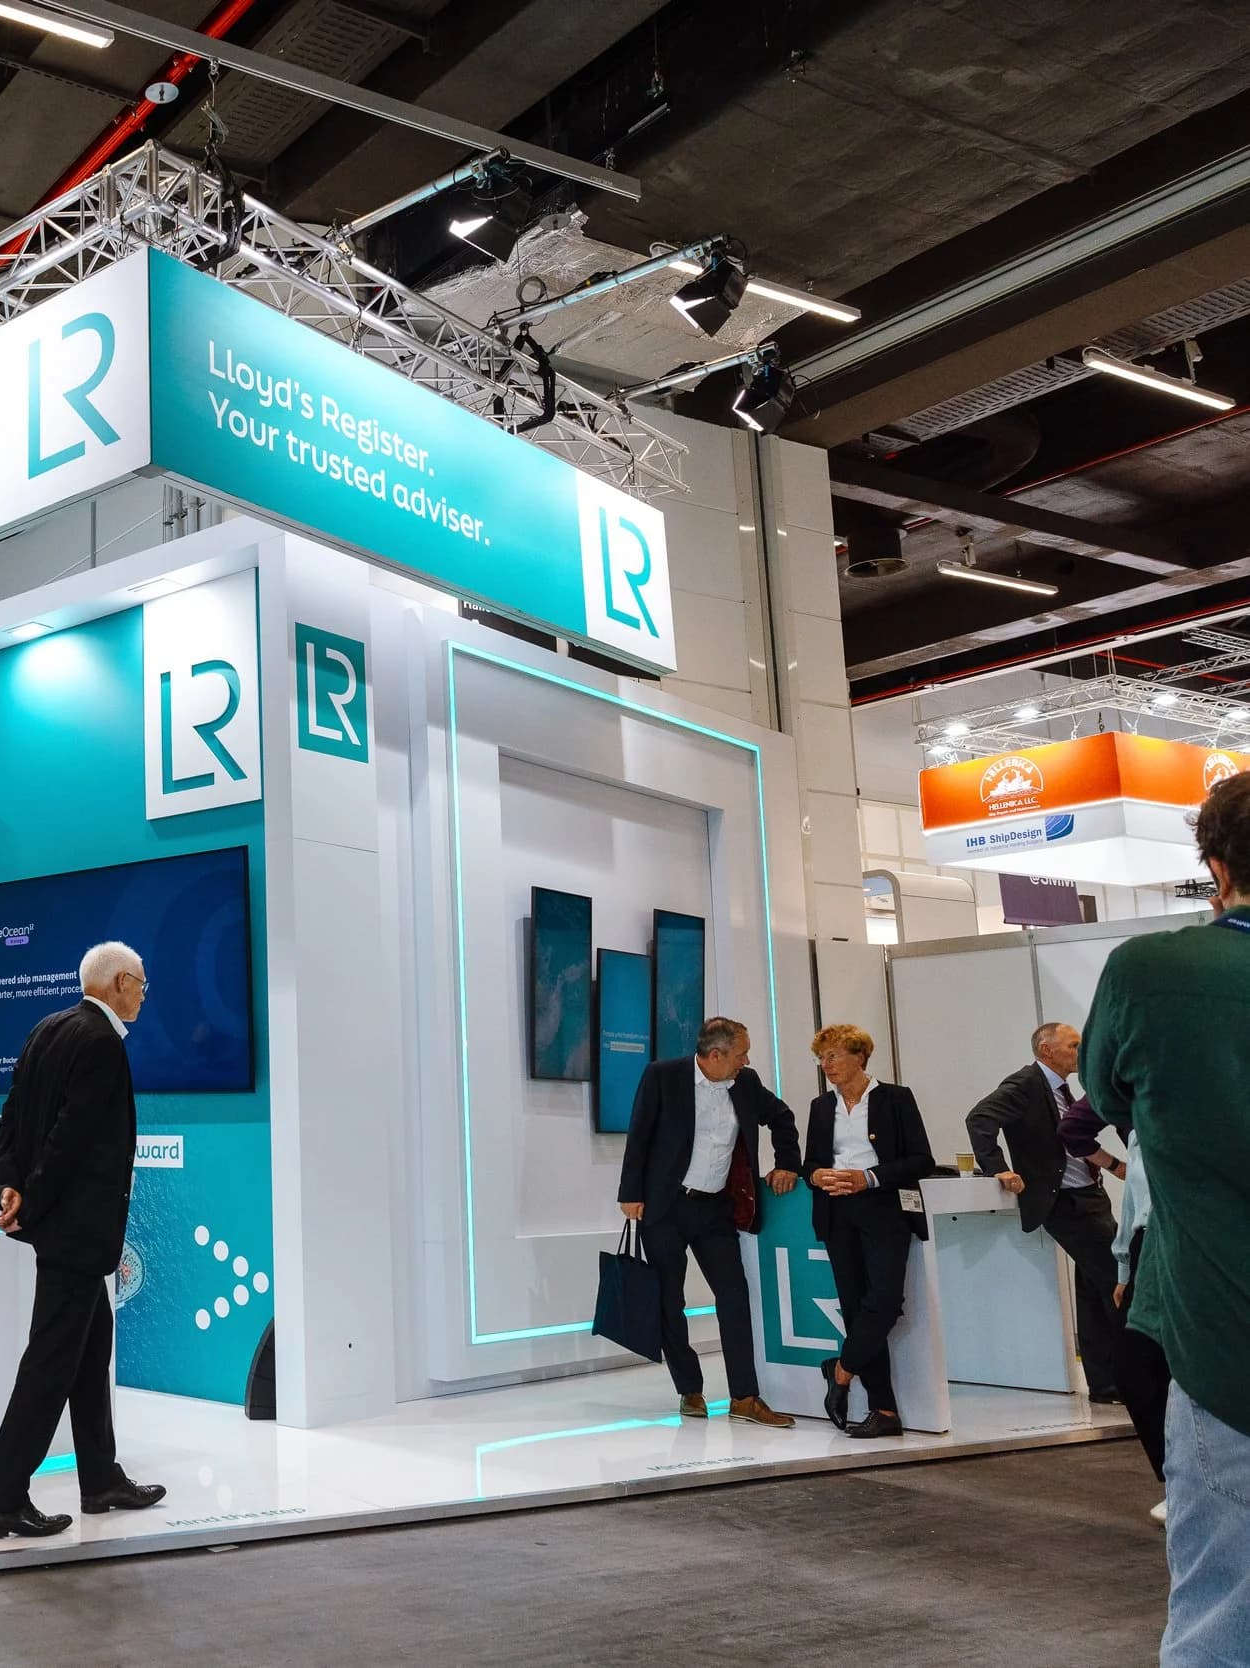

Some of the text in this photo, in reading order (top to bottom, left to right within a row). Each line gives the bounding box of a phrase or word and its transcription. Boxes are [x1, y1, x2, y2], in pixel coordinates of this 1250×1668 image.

[28, 312, 121, 480] LR
[209, 340, 435, 477] Lloyd's Register.
[208, 391, 490, 546] Your trusted adviser.
[598, 506, 660, 639] LR
[161, 659, 248, 795] LR
[306, 641, 361, 746] LR
[966, 836, 986, 848] IHB
[989, 829, 1043, 844] ShipDesign
[16, 989, 32, 997] more
[33, 986, 59, 996] efficient
[17, 974, 31, 984] ship
[32, 971, 77, 983] management
[166, 1516, 220, 1528] Mind
[221, 1512, 259, 1520] the
